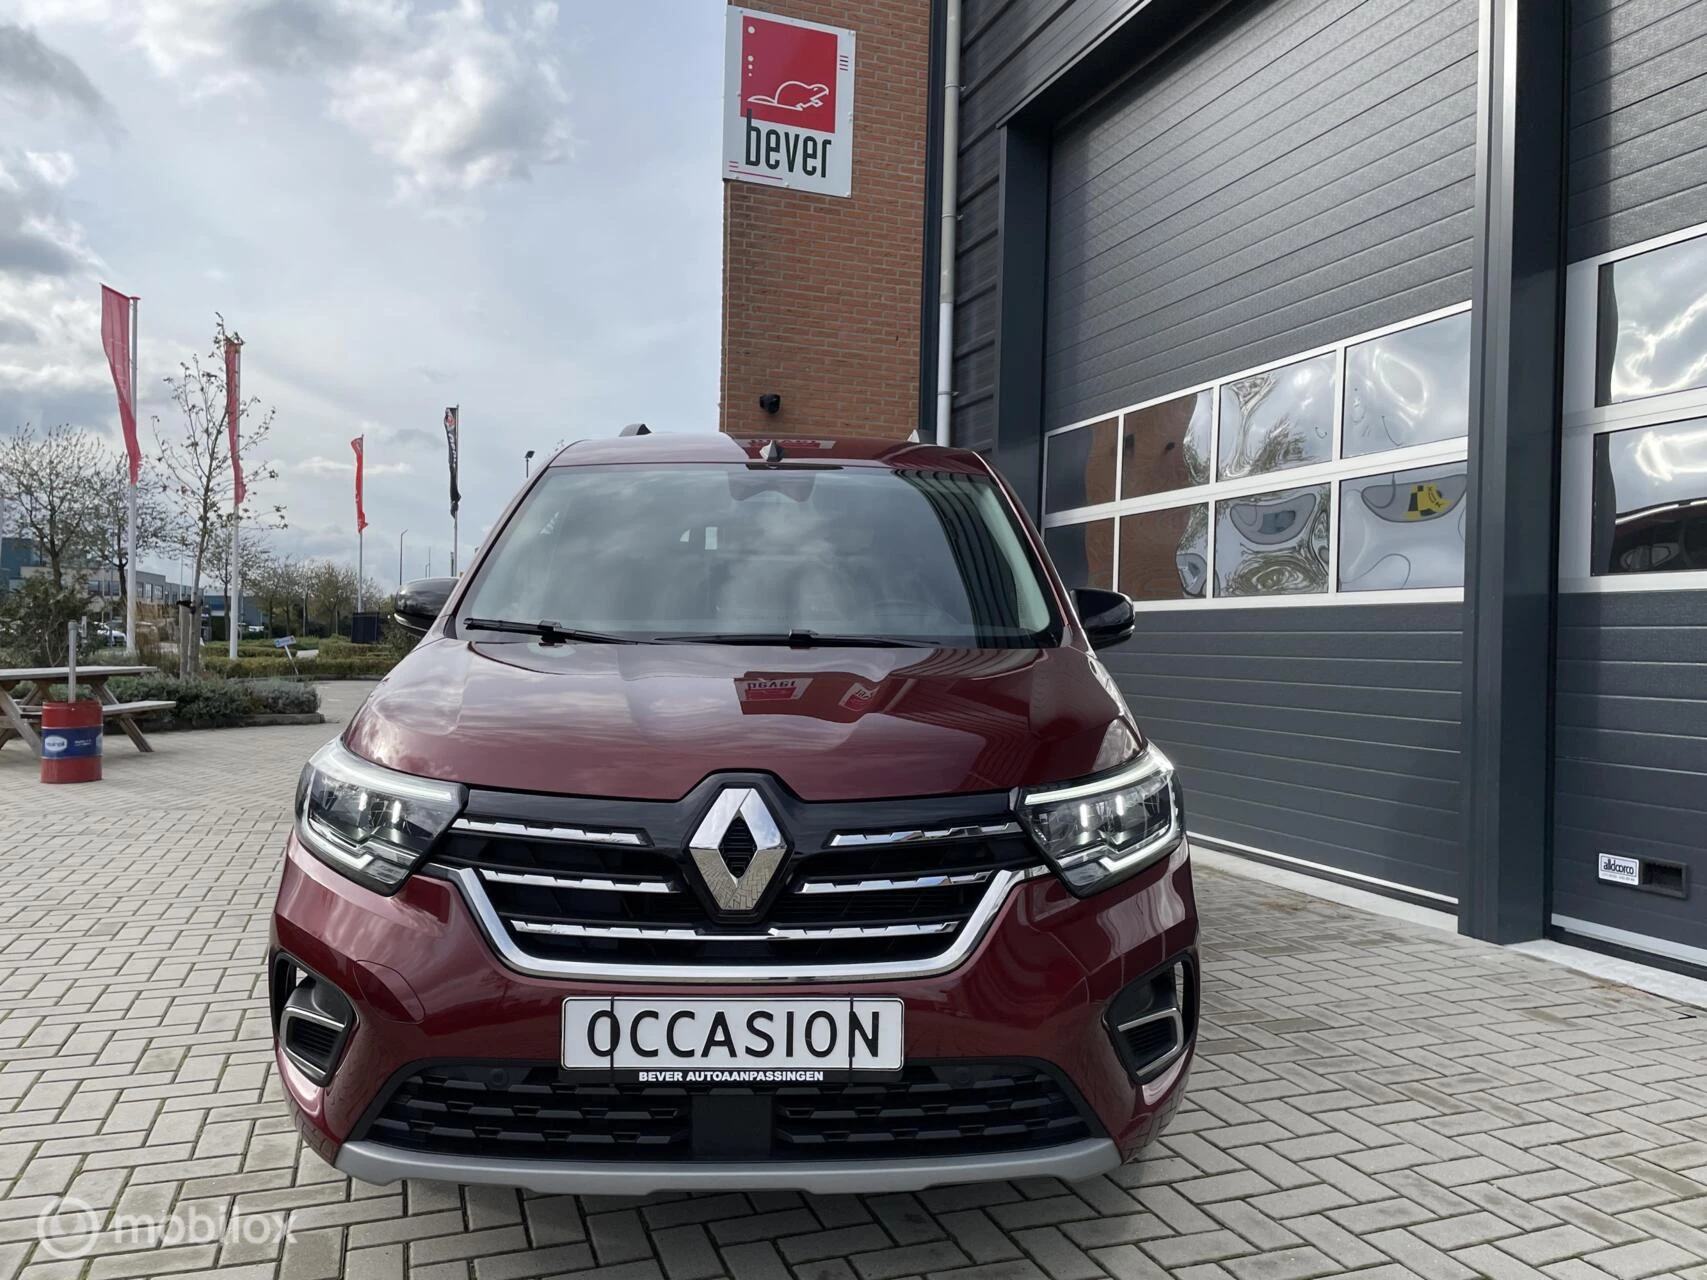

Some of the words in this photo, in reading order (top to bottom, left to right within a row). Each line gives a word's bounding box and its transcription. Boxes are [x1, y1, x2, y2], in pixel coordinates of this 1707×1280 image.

[745, 108, 832, 178] bever
[587, 1010, 880, 1058] OCCASION
[638, 1072, 683, 1081] BEVER
[686, 1072, 824, 1081] AUTOAANPASSINGEN
